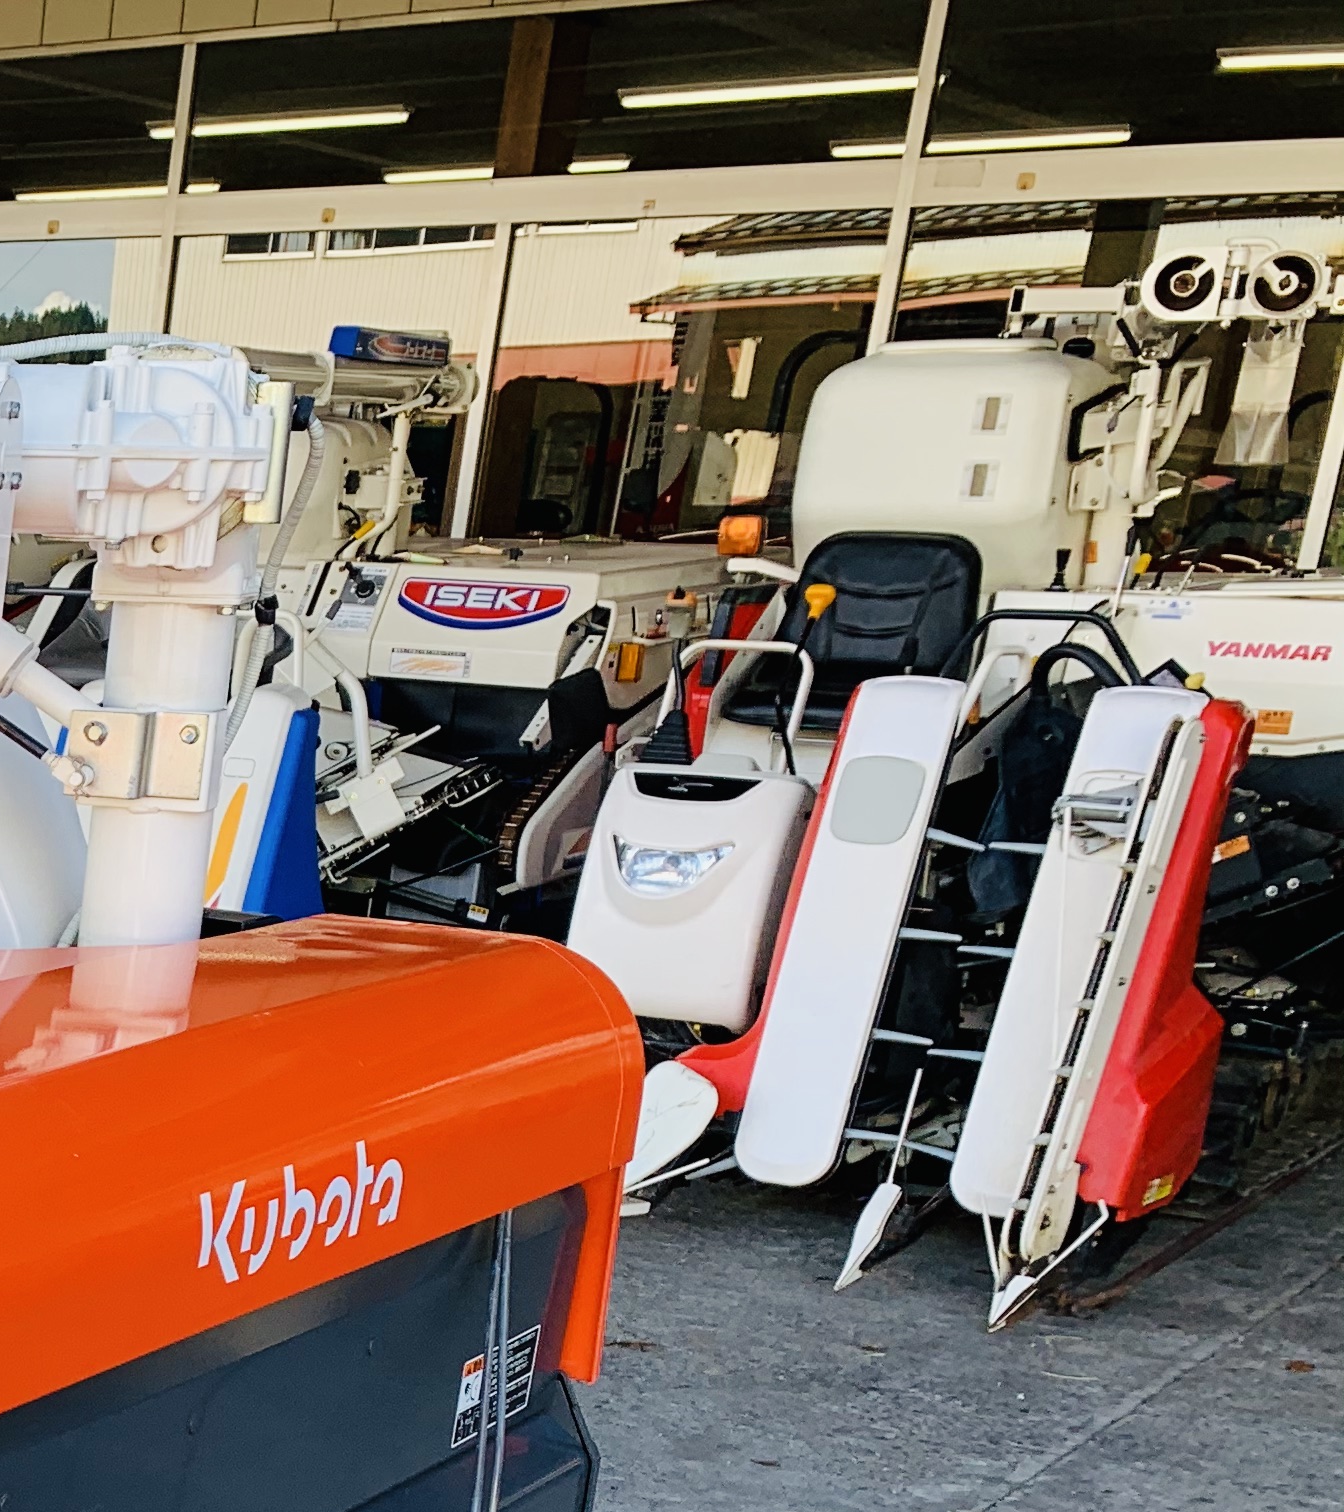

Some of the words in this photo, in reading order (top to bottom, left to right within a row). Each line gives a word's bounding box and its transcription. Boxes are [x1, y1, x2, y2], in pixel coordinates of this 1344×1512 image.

[423, 584, 542, 612] ISEKI
[1208, 641, 1333, 662] YANMAR
[197, 1139, 404, 1284] Kubota
